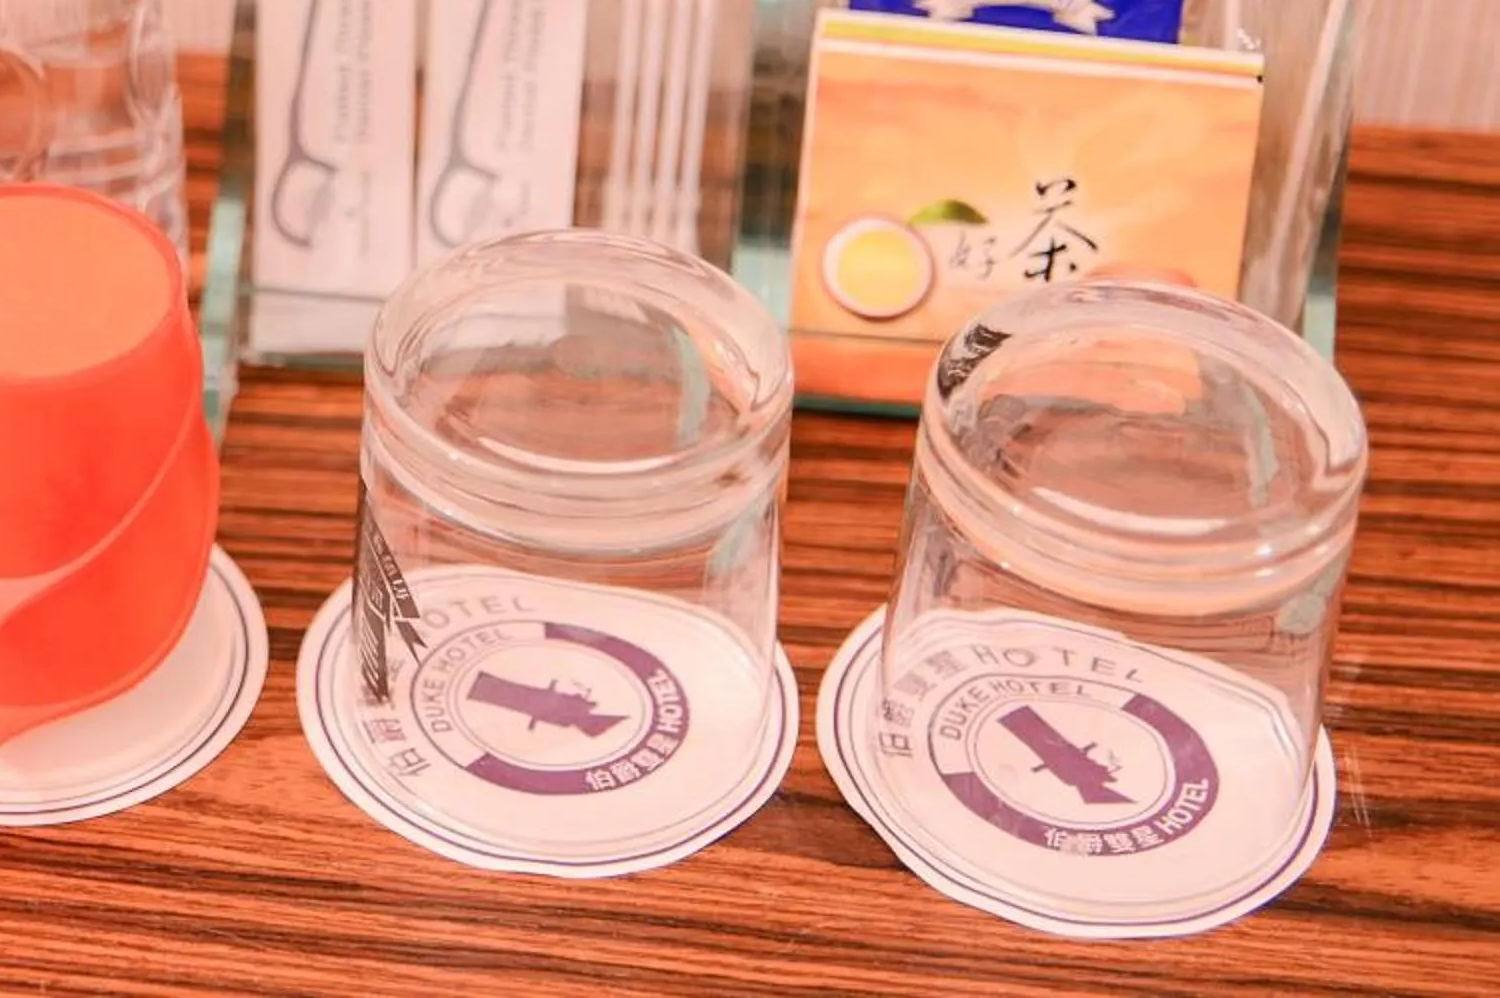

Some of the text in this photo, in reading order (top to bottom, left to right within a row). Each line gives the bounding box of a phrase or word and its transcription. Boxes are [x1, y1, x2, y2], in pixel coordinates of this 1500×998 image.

[418, 595, 536, 636] OTEL
[422, 627, 514, 734] DUKE HOTEL
[969, 642, 1146, 684] HOTEL
[646, 668, 683, 734] HOTEL
[939, 677, 1092, 742] DUKE HOTEL
[1152, 777, 1209, 835] HOTEL
